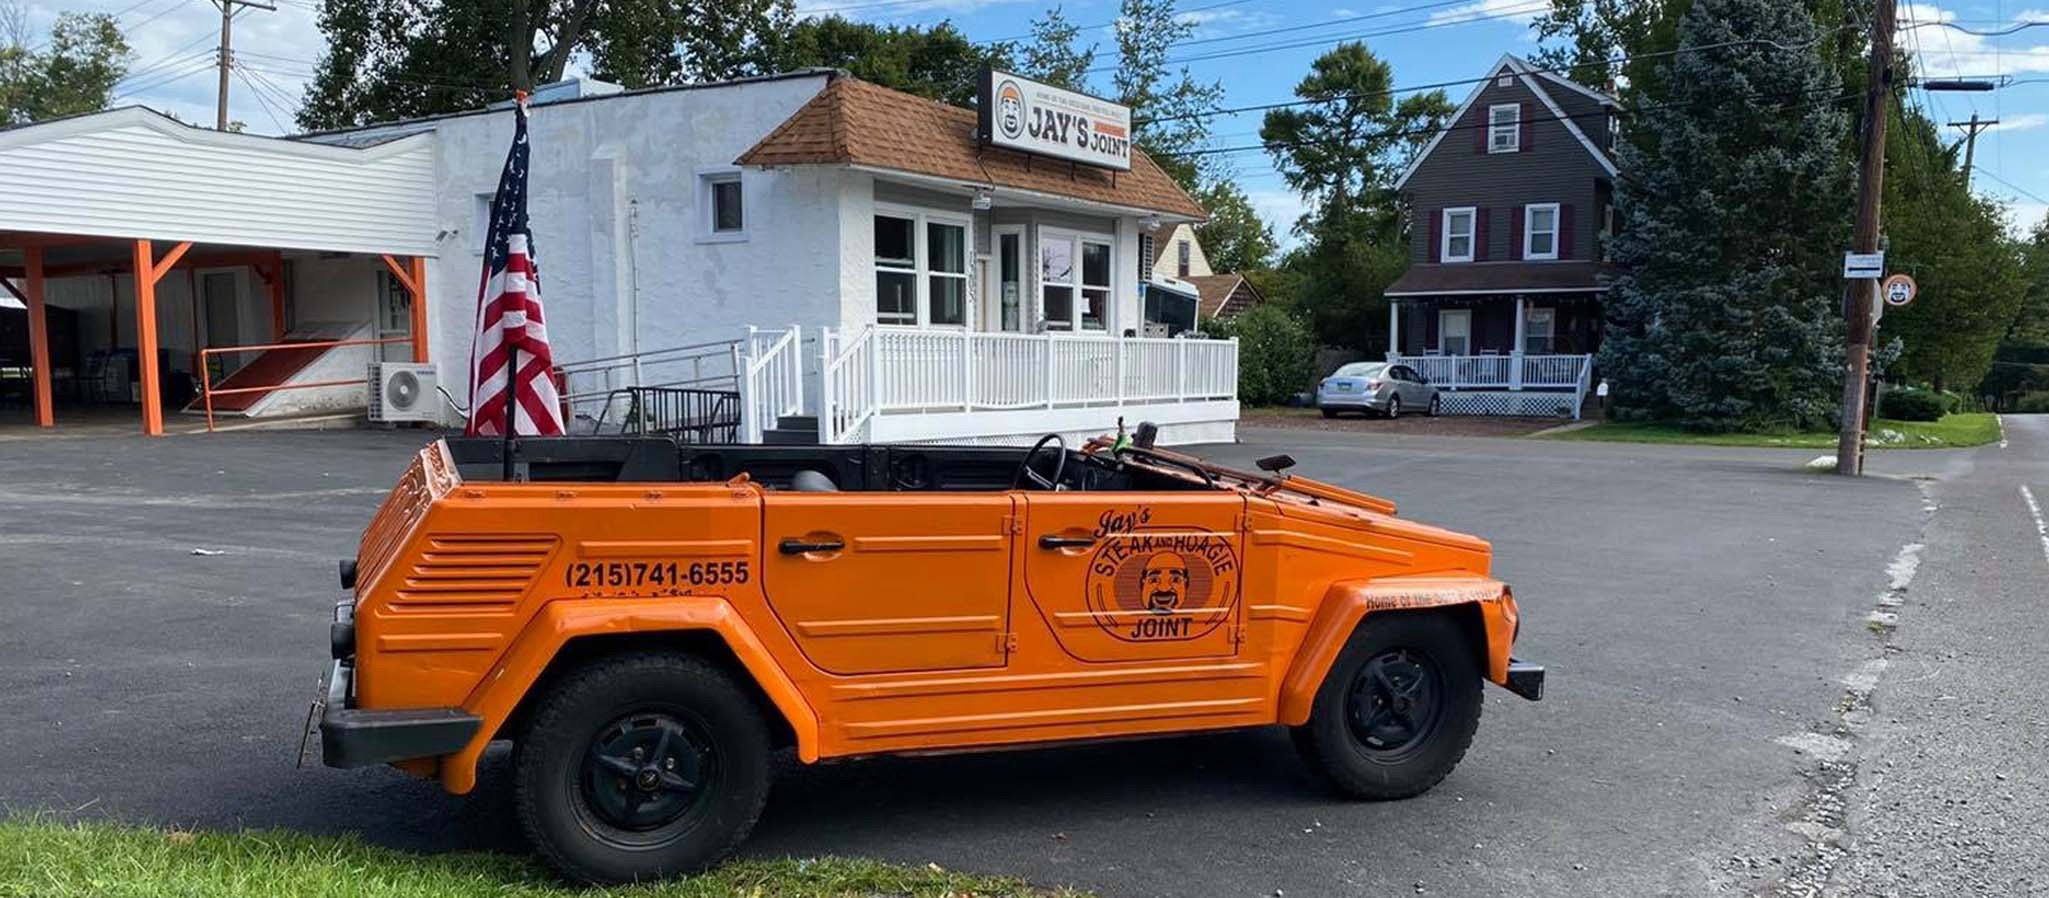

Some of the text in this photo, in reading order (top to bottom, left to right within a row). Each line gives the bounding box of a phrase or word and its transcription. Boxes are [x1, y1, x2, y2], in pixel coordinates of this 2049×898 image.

[1028, 107, 1089, 148] JAY'S
[1090, 133, 1128, 158] JOINT
[1094, 504, 1150, 539] Jay's
[1094, 535, 1153, 577] STEAK
[1173, 535, 1233, 577] HOAGIE
[566, 561, 749, 588] (215)741-6555
[1366, 593, 1397, 609] Home
[1131, 617, 1193, 639] JOINT
